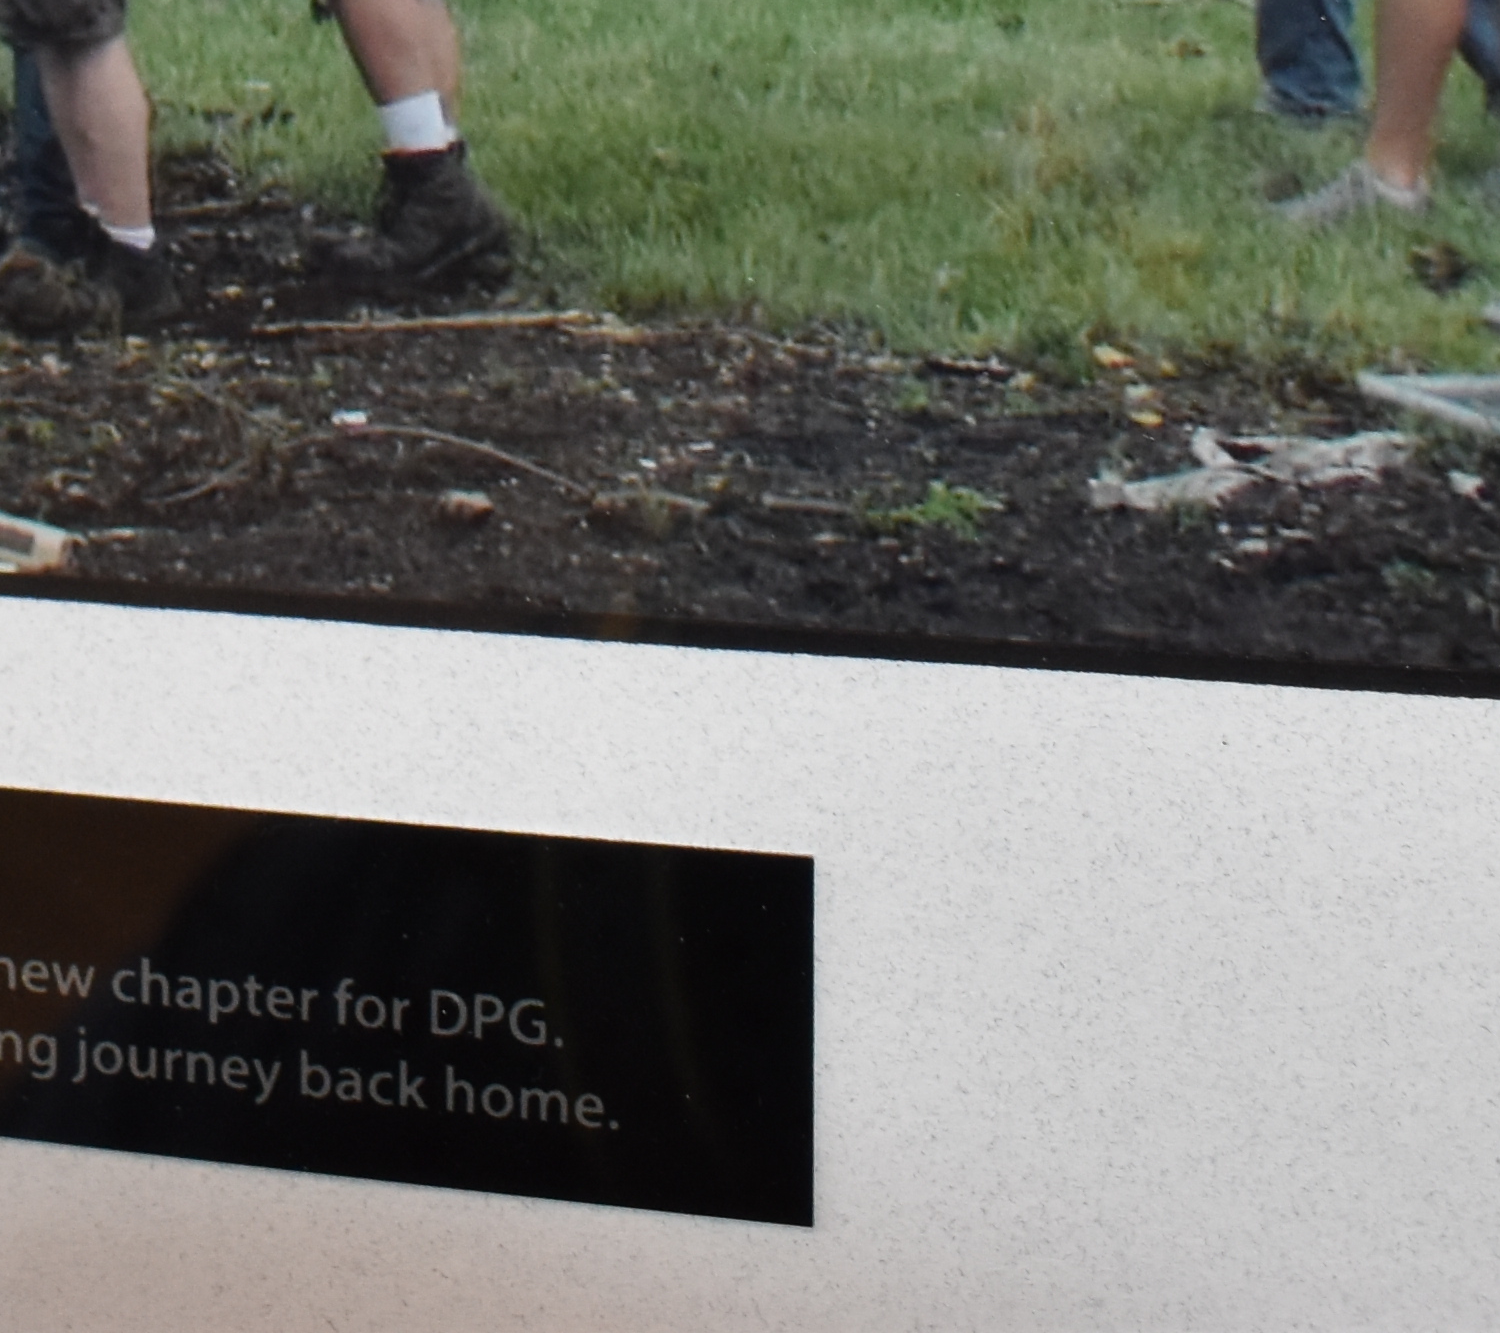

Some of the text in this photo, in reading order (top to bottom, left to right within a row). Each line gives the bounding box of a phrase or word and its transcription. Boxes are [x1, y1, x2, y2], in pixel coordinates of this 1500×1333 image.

[111, 957, 319, 1024] chapter
[333, 977, 410, 1031] for
[430, 989, 564, 1048] DPG.
[72, 1026, 281, 1104] journey
[300, 1049, 426, 1109] back
[446, 1065, 619, 1130] home.
